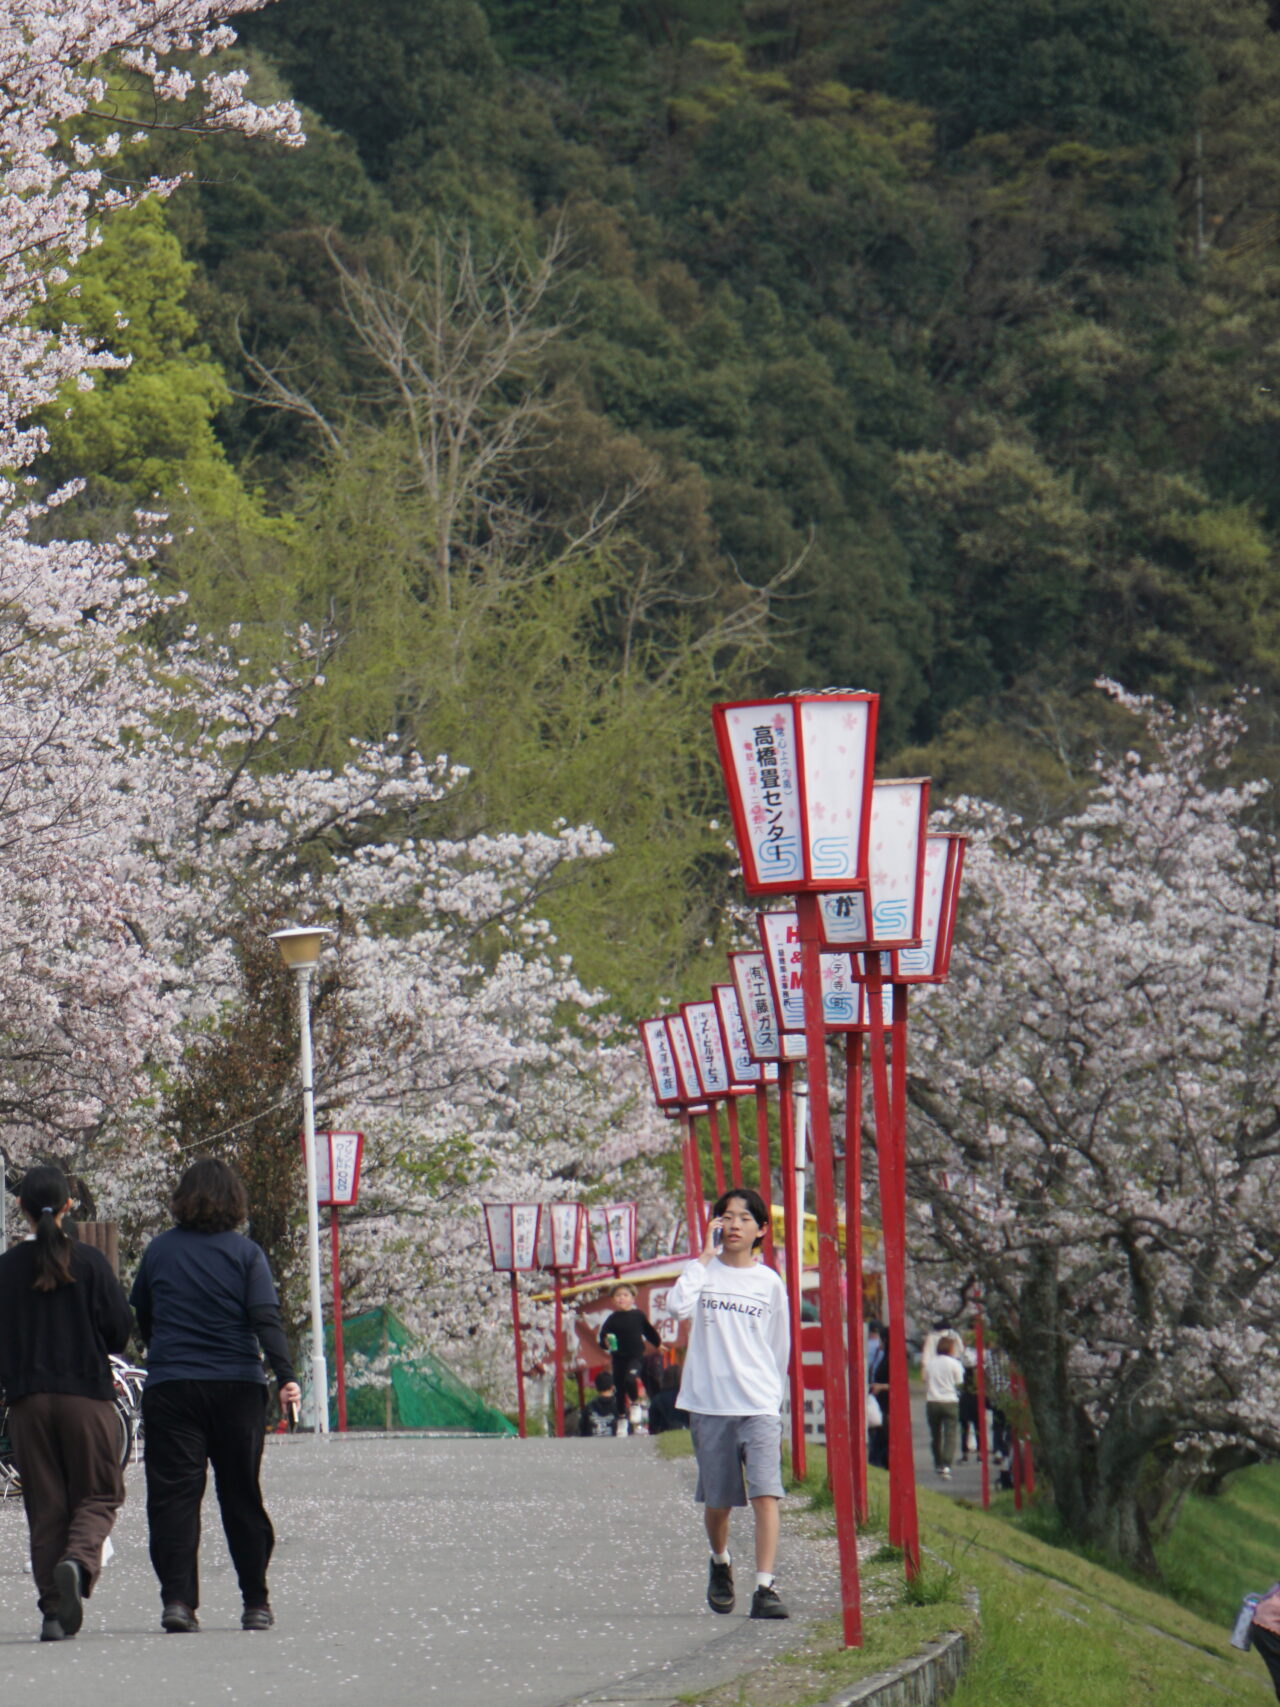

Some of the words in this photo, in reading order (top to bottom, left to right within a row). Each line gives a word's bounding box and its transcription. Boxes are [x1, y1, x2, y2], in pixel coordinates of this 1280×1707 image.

[752, 725, 784, 861] 高橋畳センター
[700, 1298, 763, 1318] SIGNALIZE
